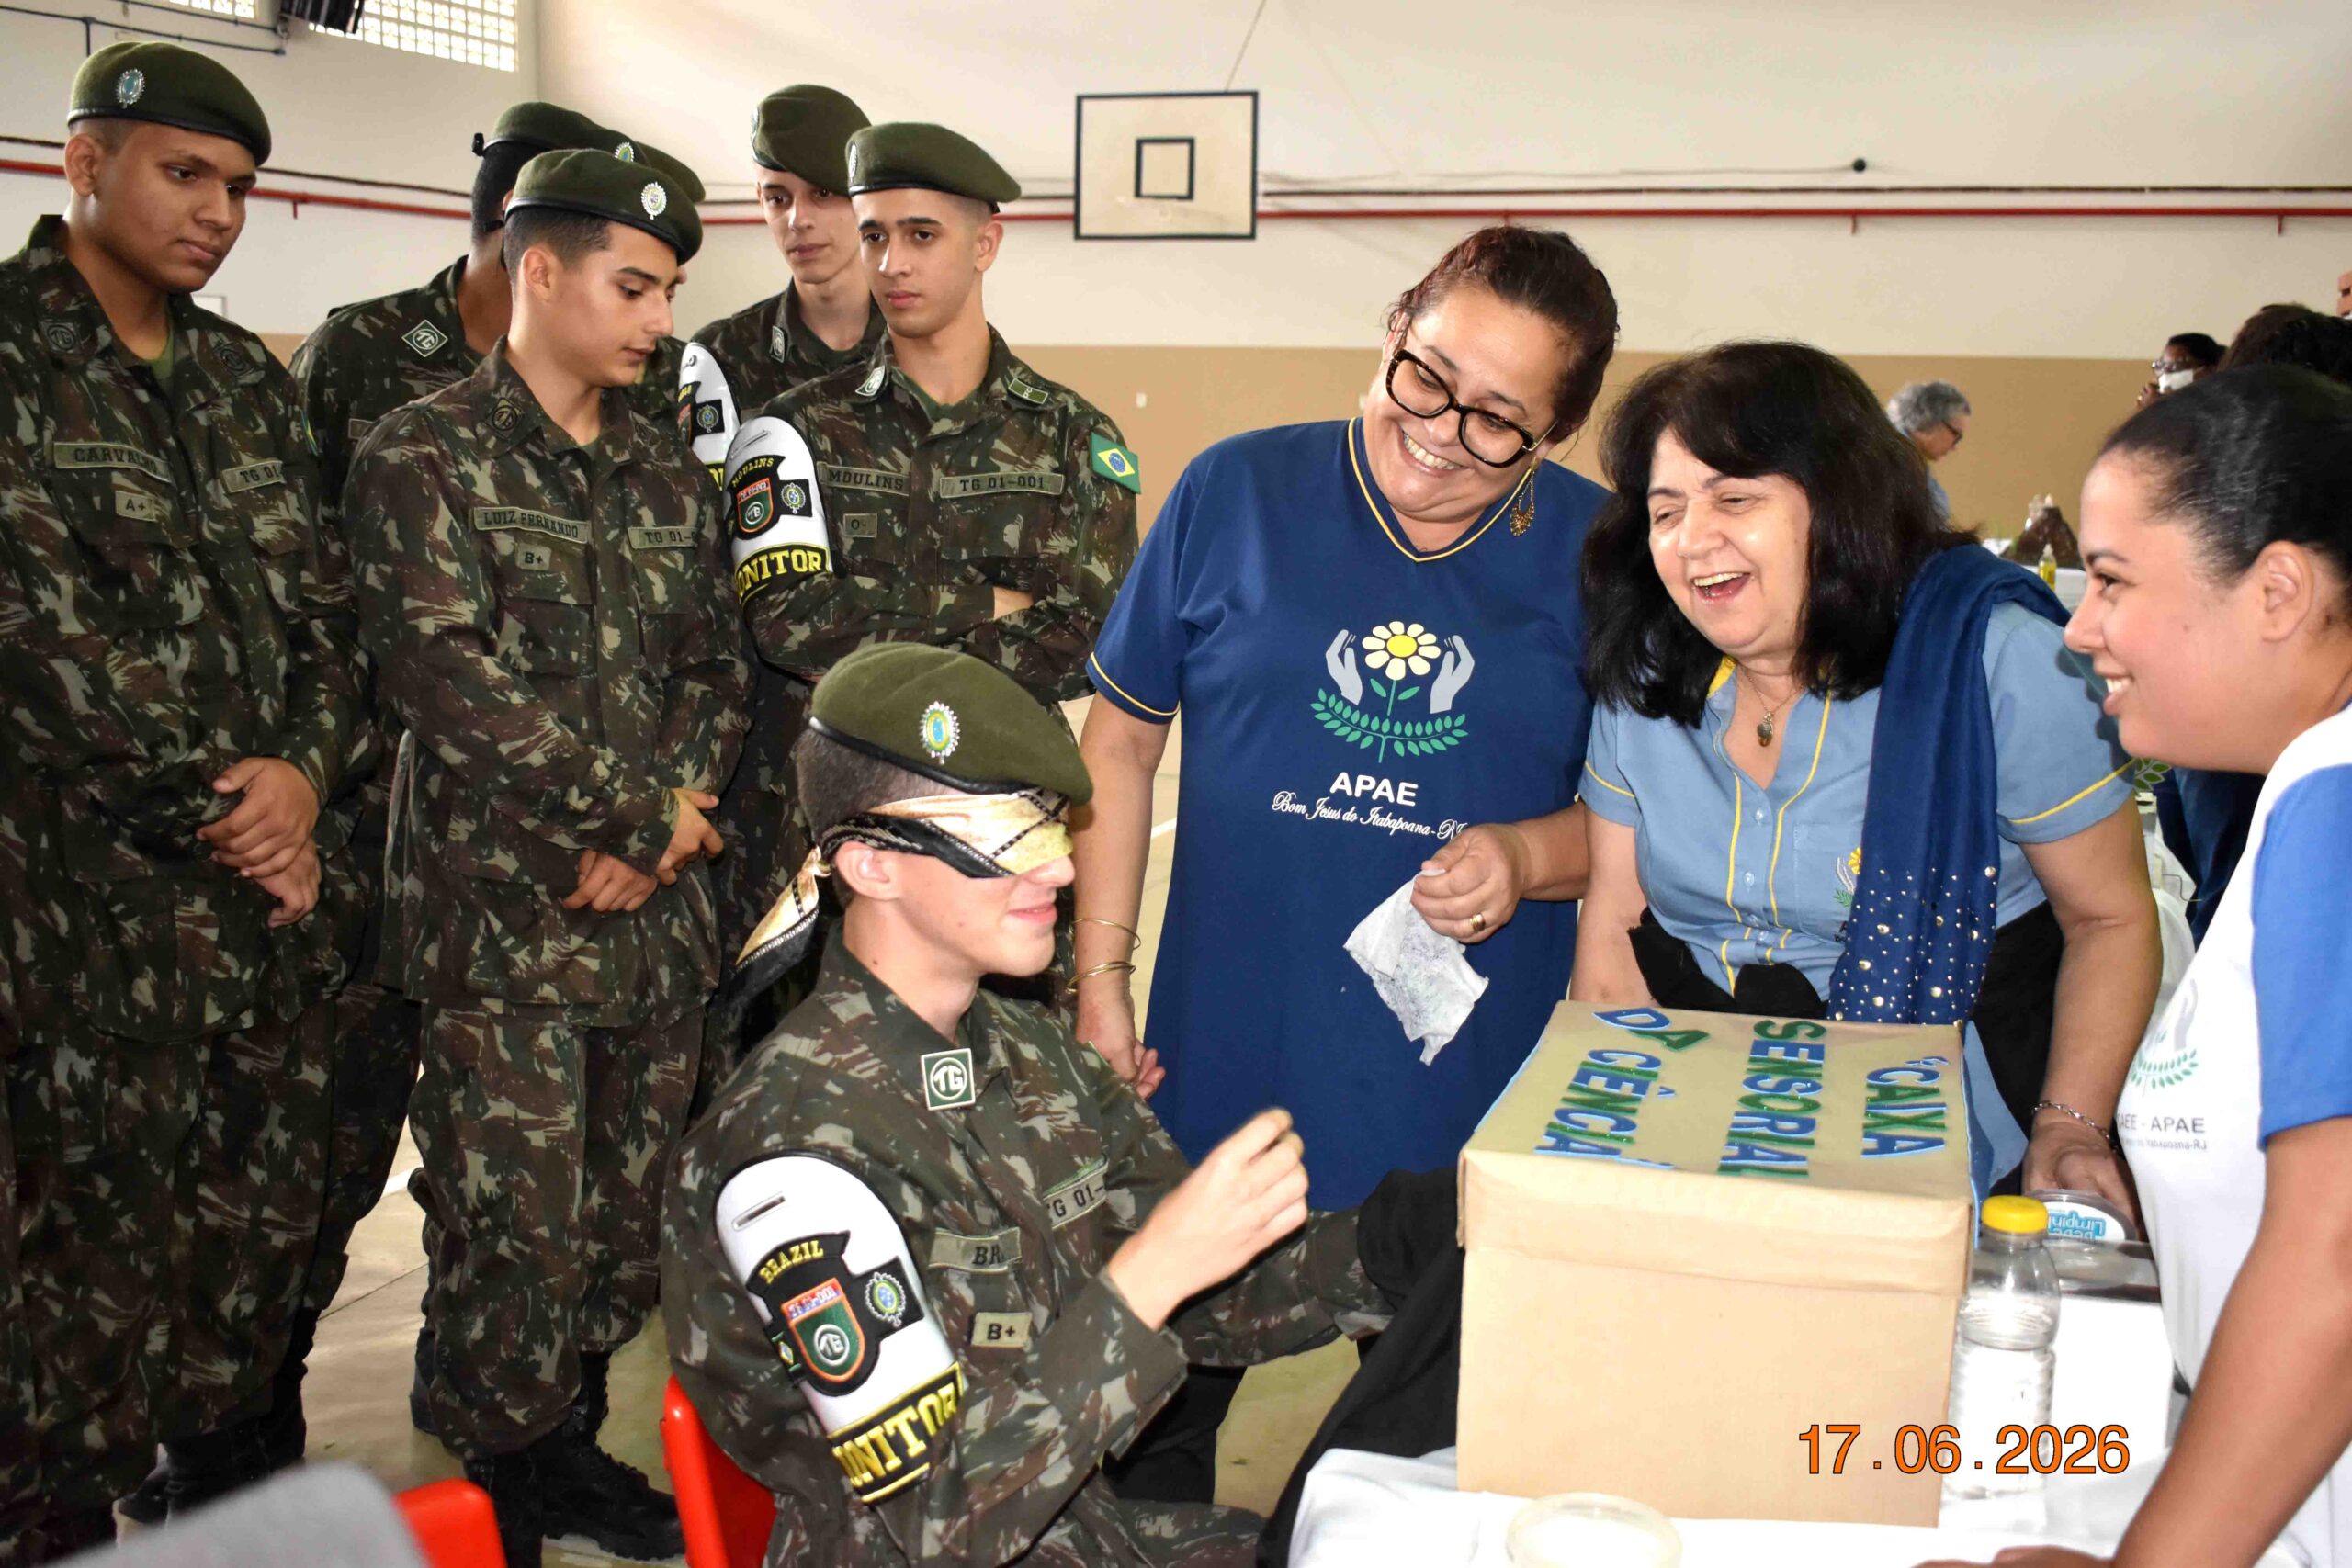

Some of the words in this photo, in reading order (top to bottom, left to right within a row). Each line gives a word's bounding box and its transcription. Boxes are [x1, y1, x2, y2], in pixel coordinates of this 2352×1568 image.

[239, 468, 260, 483] TG
[731, 457, 775, 487] MOULINS
[828, 469, 905, 491] MOULINS
[960, 479, 980, 491] TG
[988, 475, 1045, 489] 01-001
[125, 498, 147, 512] A+
[484, 511, 516, 525] LUIZ
[520, 513, 579, 538] FERNANDO
[644, 531, 663, 543] TG
[524, 552, 544, 564] B+
[737, 548, 822, 598] ONITOR
[1329, 772, 1419, 807] APAE
[1272, 790, 1307, 814] Bom
[1306, 796, 1341, 820] Jesus
[1342, 806, 1358, 822] do
[1593, 1008, 1710, 1052] DA
[1718, 1019, 1827, 1176] SENSORIAL
[2150, 1116, 2206, 1134] APAE
[1047, 1199, 1067, 1217] G
[759, 1240, 825, 1284] BRAZIL
[987, 1324, 1016, 1340] B+
[831, 1382, 957, 1486] ONITOR
